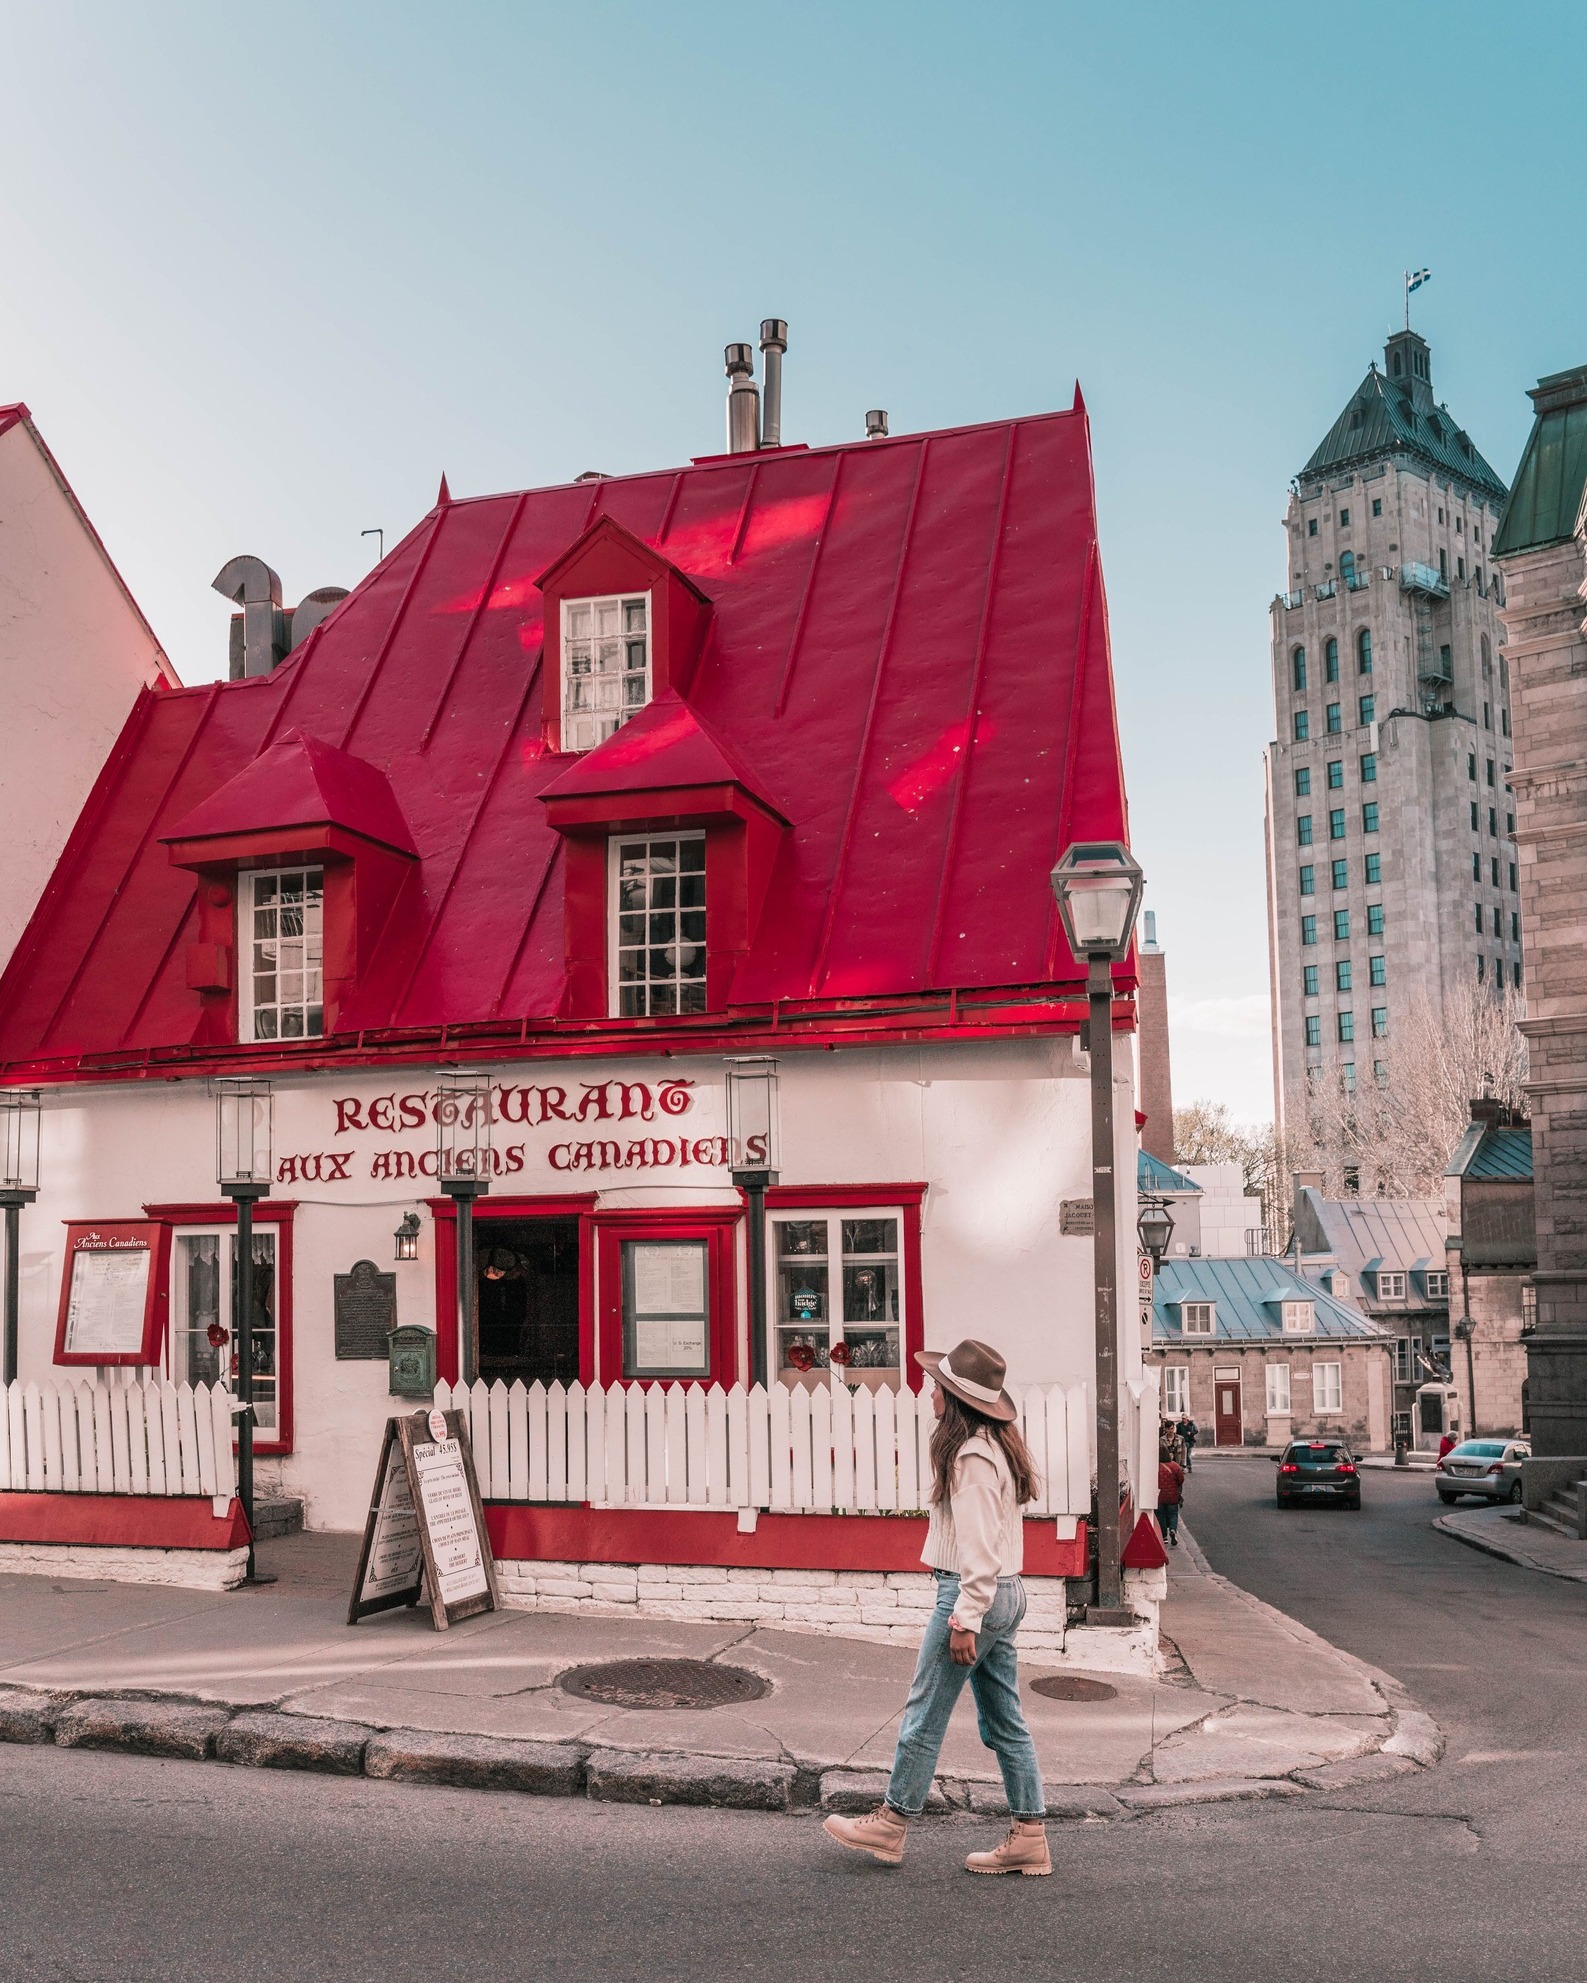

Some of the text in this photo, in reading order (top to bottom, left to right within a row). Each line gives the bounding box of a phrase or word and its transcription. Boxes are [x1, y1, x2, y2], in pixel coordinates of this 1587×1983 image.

[333, 1079, 695, 1136] RESTAURANT
[277, 1132, 768, 1184] AUX ANCIENS CANADIENS
[74, 1236, 148, 1249] Anciens Canadiens
[415, 1446, 436, 1461] Spécial
